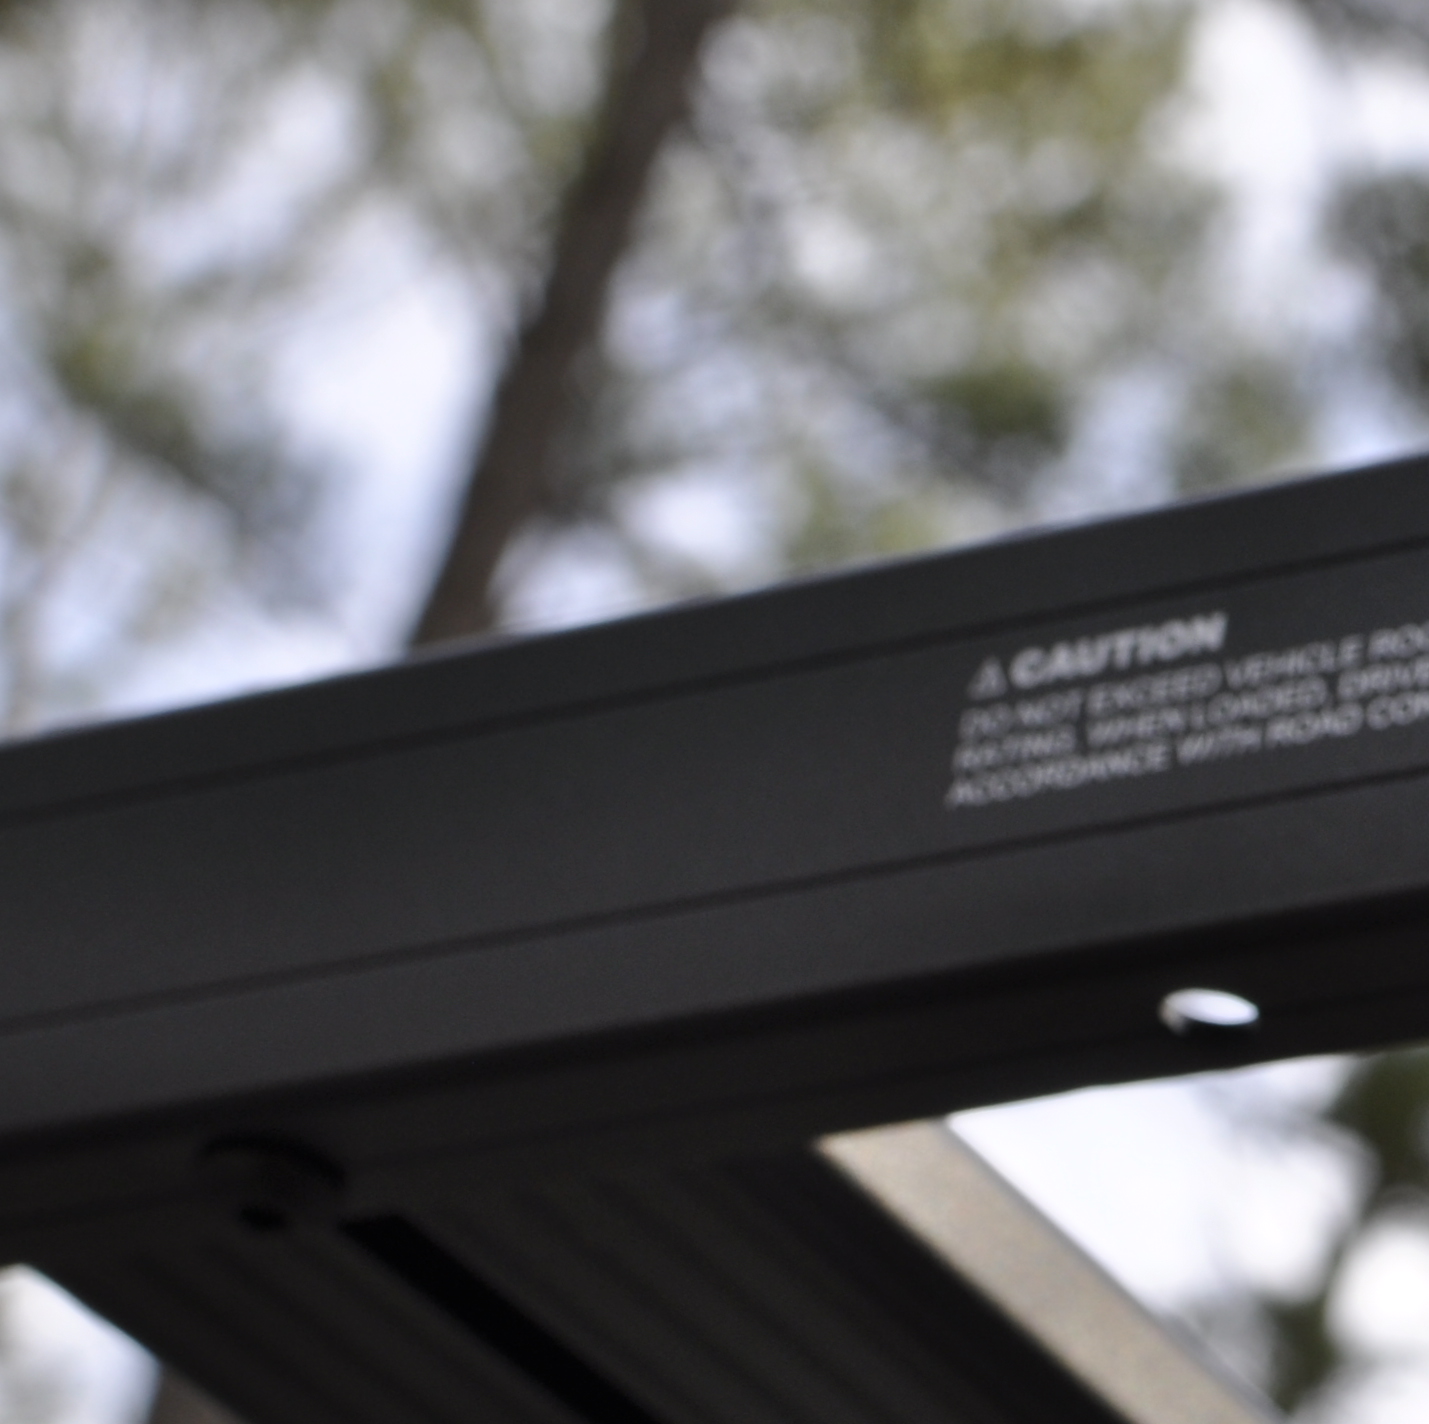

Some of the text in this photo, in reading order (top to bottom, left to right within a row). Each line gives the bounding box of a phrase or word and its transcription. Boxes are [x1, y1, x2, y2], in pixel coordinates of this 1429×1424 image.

[959, 704, 1014, 740] DO
[1014, 690, 1083, 725] NOT
[1085, 663, 1222, 716] EXCEED
[1224, 634, 1364, 691] VEHICLE
[1009, 613, 1226, 688] CAUTION
[946, 741, 1170, 808] ACCORDANCE
[1176, 725, 1263, 765] WITH
[1264, 703, 1363, 748] ROAD
[1085, 707, 1186, 748] WHEN
